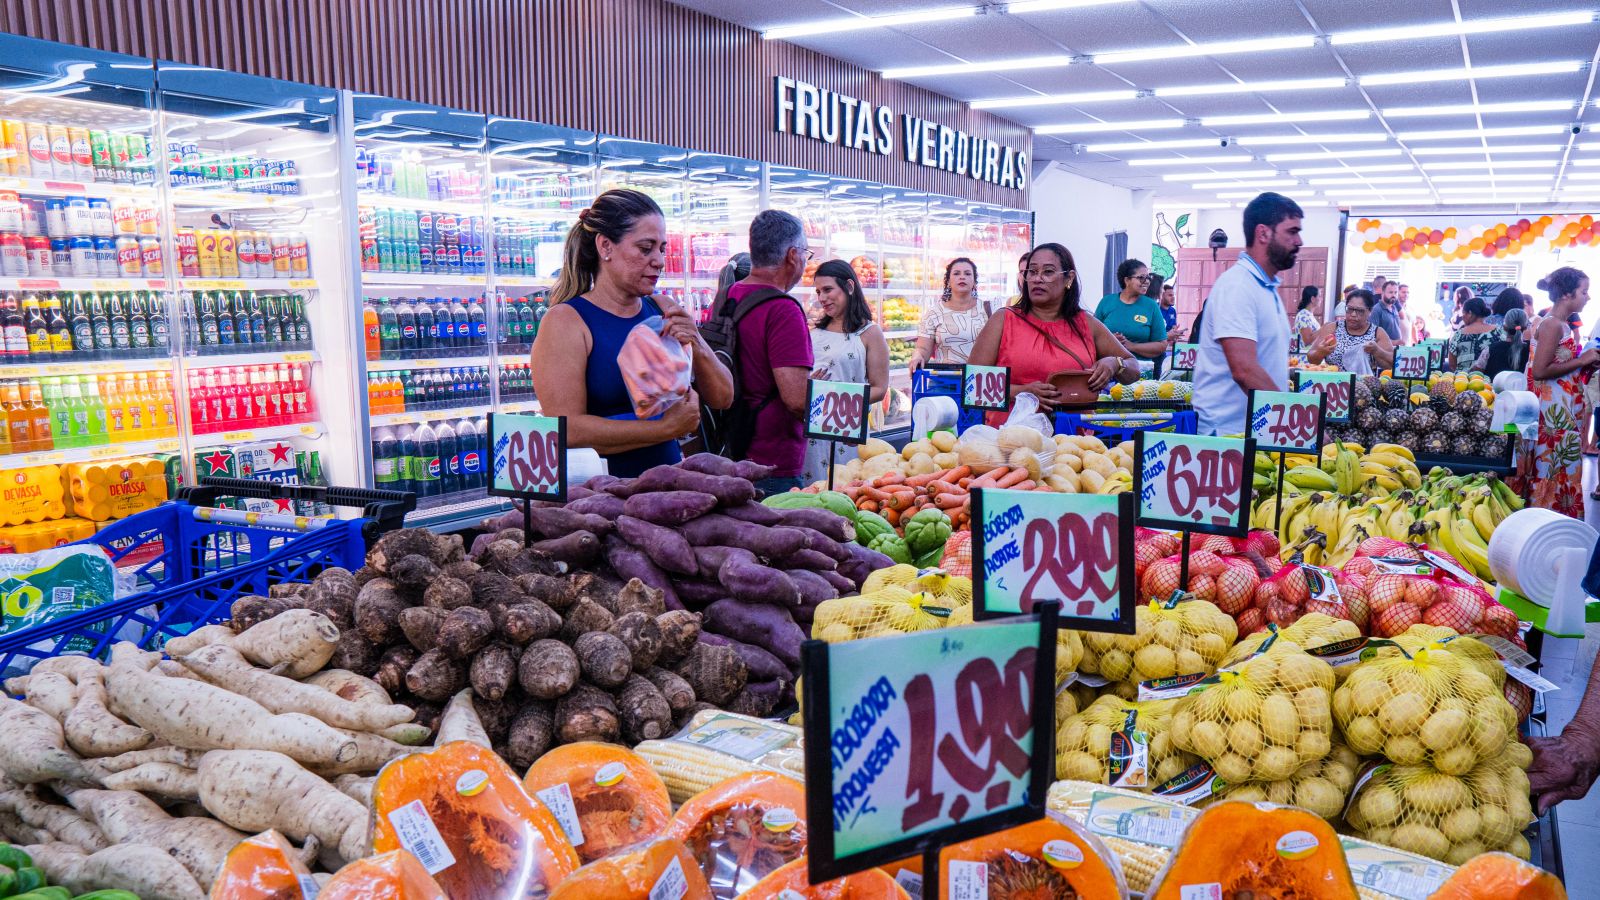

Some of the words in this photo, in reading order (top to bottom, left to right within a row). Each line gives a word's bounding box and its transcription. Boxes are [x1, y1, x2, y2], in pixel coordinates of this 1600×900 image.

[774, 76, 893, 155] FRUTAS
[901, 114, 1027, 190] VERDURAS
[4, 484, 42, 501] DEVASSA
[109, 481, 147, 497] DEVASSA
[982, 503, 1024, 546] BÓBORA
